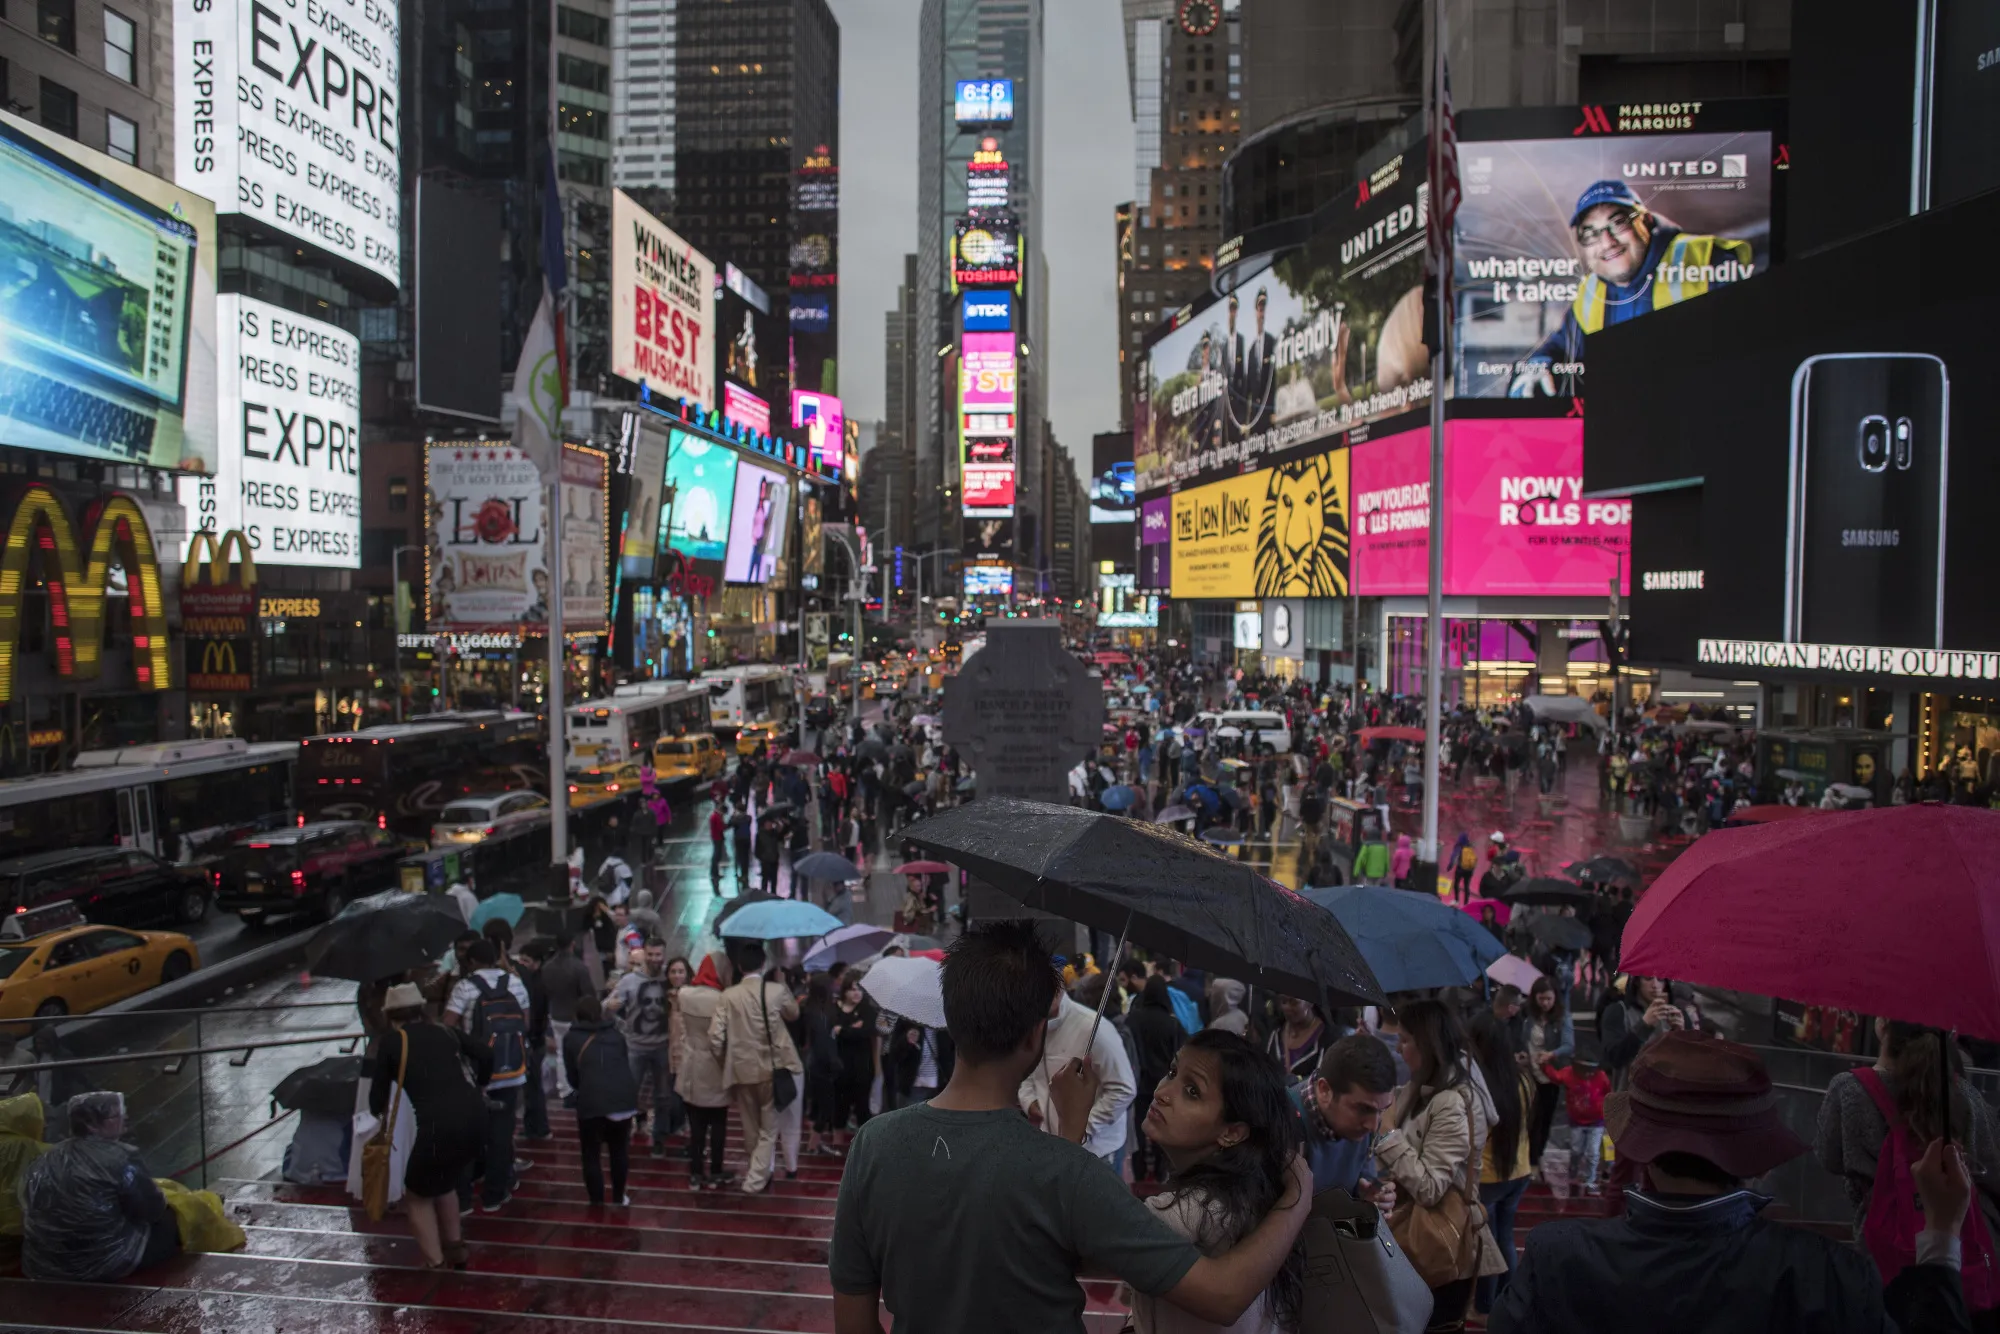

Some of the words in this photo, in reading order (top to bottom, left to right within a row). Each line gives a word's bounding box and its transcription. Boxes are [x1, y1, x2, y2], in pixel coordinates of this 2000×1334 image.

[252, 0, 394, 154] EXPRE
[193, 40, 214, 173] EXPRESS
[1619, 102, 1702, 118] MARRIOTT
[275, 97, 356, 163] EXPRESS
[1619, 117, 1692, 131] MARQUIS
[1622, 161, 1718, 177] UNITED
[308, 162, 381, 219] EXPRESS
[276, 194, 356, 250] EXPRESS
[1341, 203, 1414, 265] UNITED
[956, 269, 1018, 283] TOSHIBA
[1468, 256, 1579, 278] whatever
[1493, 283, 1510, 303] it
[1515, 280, 1578, 303] takes
[635, 284, 701, 366] BEST
[976, 304, 1008, 317] TDK
[271, 319, 348, 366] EXPRESS
[1275, 311, 1342, 370] friendly
[1477, 360, 1513, 376] Every
[1171, 385, 1199, 418] extra
[1280, 417, 1318, 442] customer
[1354, 398, 1370, 418] the
[1369, 385, 1409, 413] friendly
[244, 401, 356, 476] EXPRE
[1358, 492, 1382, 514] NOW
[1383, 486, 1413, 509] YOUR
[1500, 476, 1563, 501] NOW
[1177, 508, 1193, 536] THE
[1222, 490, 1251, 538] KING
[274, 527, 349, 555] EXPRESS
[1842, 529, 1900, 546] SAMSUNG
[259, 598, 321, 617] EXPRESS
[1700, 641, 1808, 669] AMERICAN
[1818, 646, 1894, 674] EAGLE
